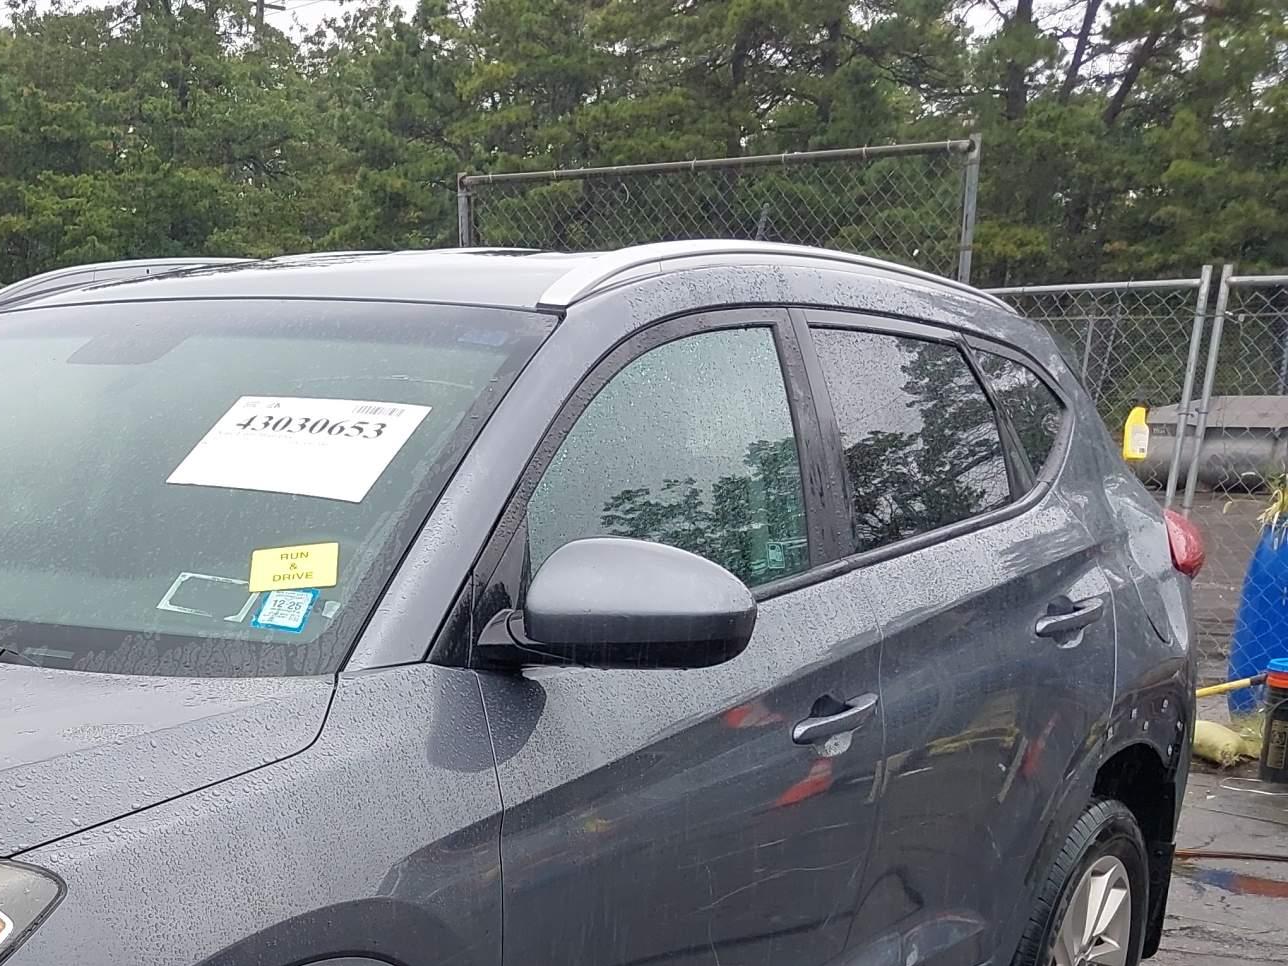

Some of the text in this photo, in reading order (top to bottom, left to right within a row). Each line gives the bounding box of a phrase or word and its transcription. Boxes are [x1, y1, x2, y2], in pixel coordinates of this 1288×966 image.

[236, 415, 387, 439] 43030653
[280, 551, 309, 561] RUN
[289, 562, 297, 571] &
[272, 571, 314, 582] DRIVE
